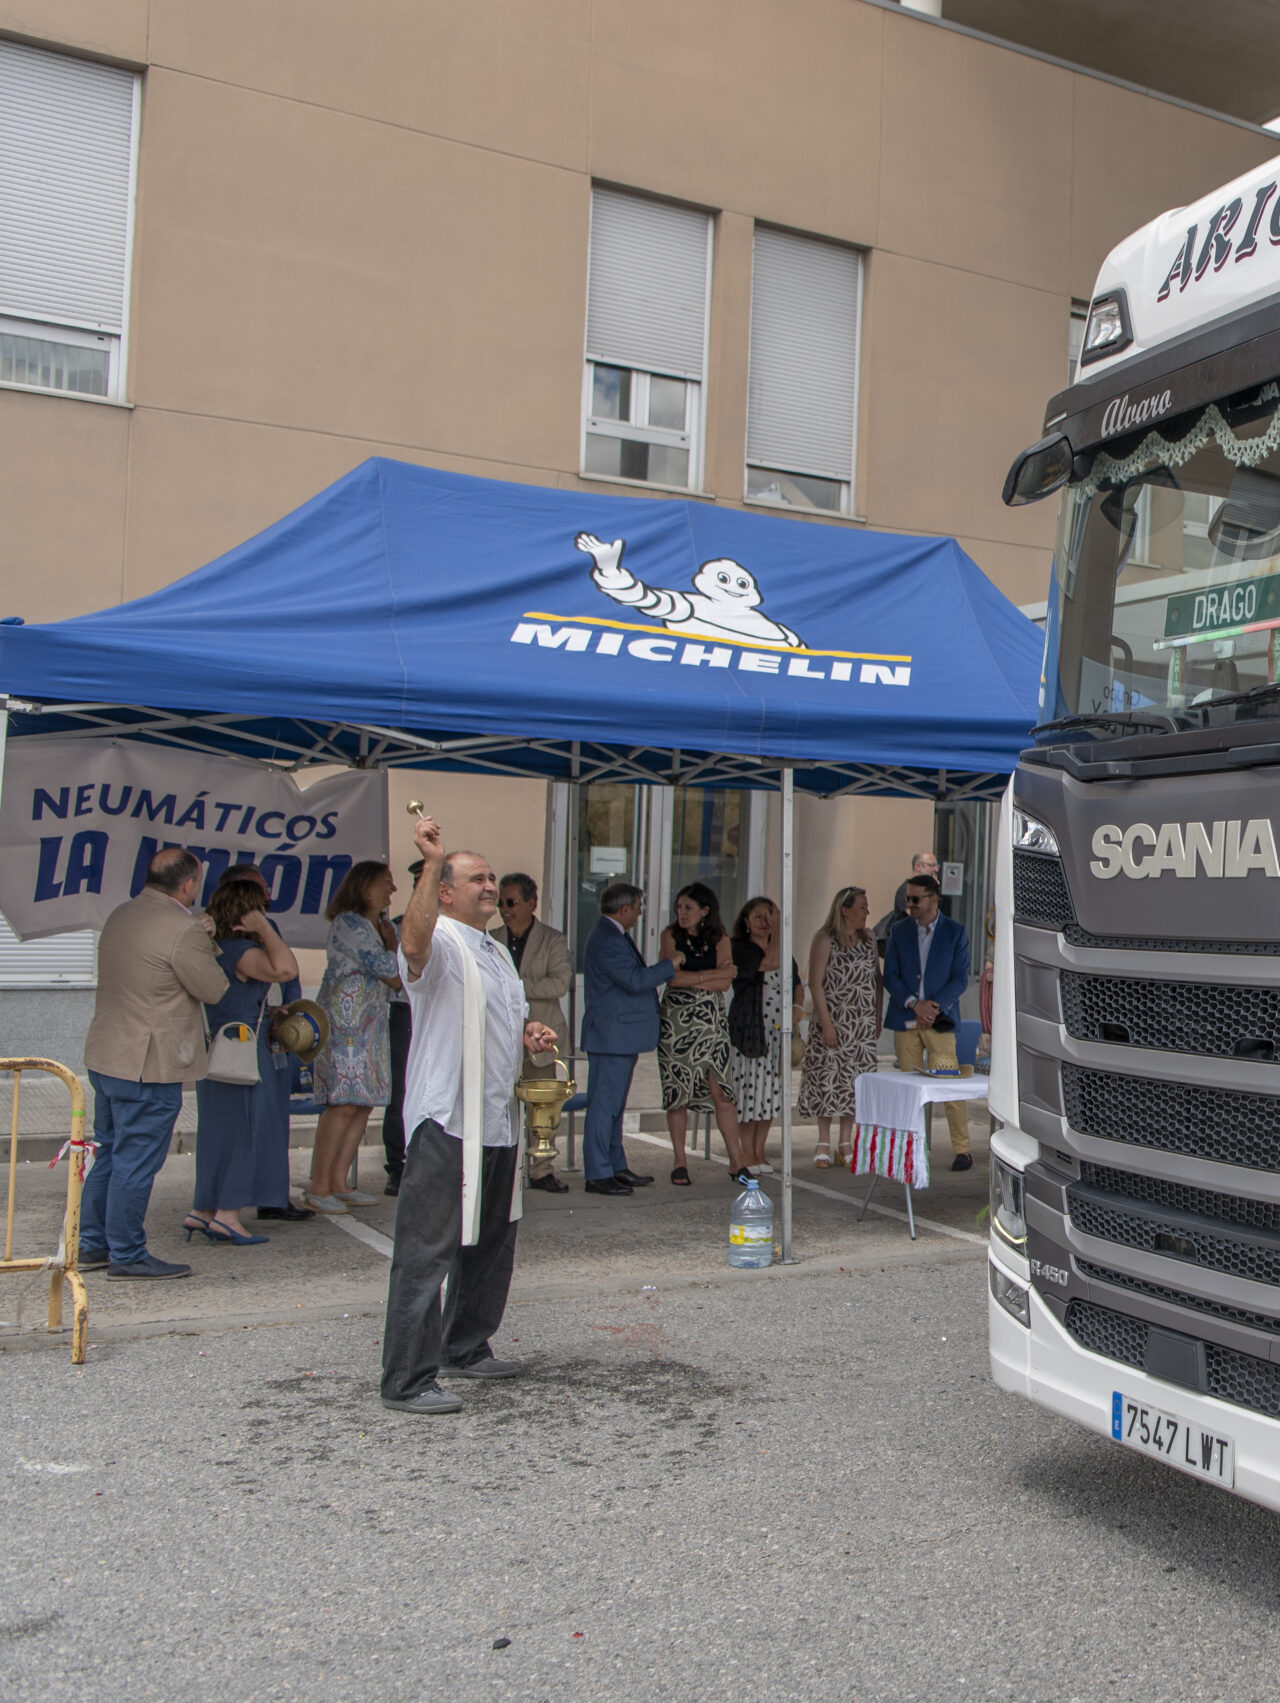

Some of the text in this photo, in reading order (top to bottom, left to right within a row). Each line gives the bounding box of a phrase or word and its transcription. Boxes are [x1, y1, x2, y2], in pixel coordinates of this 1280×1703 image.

[1101, 389, 1173, 438] Alvaro
[1192, 584, 1257, 629] DRAGO
[510, 621, 912, 687] MICHELIN
[32, 783, 339, 842] NEUMÁTICOS
[33, 830, 110, 903] LA
[1127, 1403, 1178, 1455] 7547
[1185, 1426, 1229, 1477] LWT
